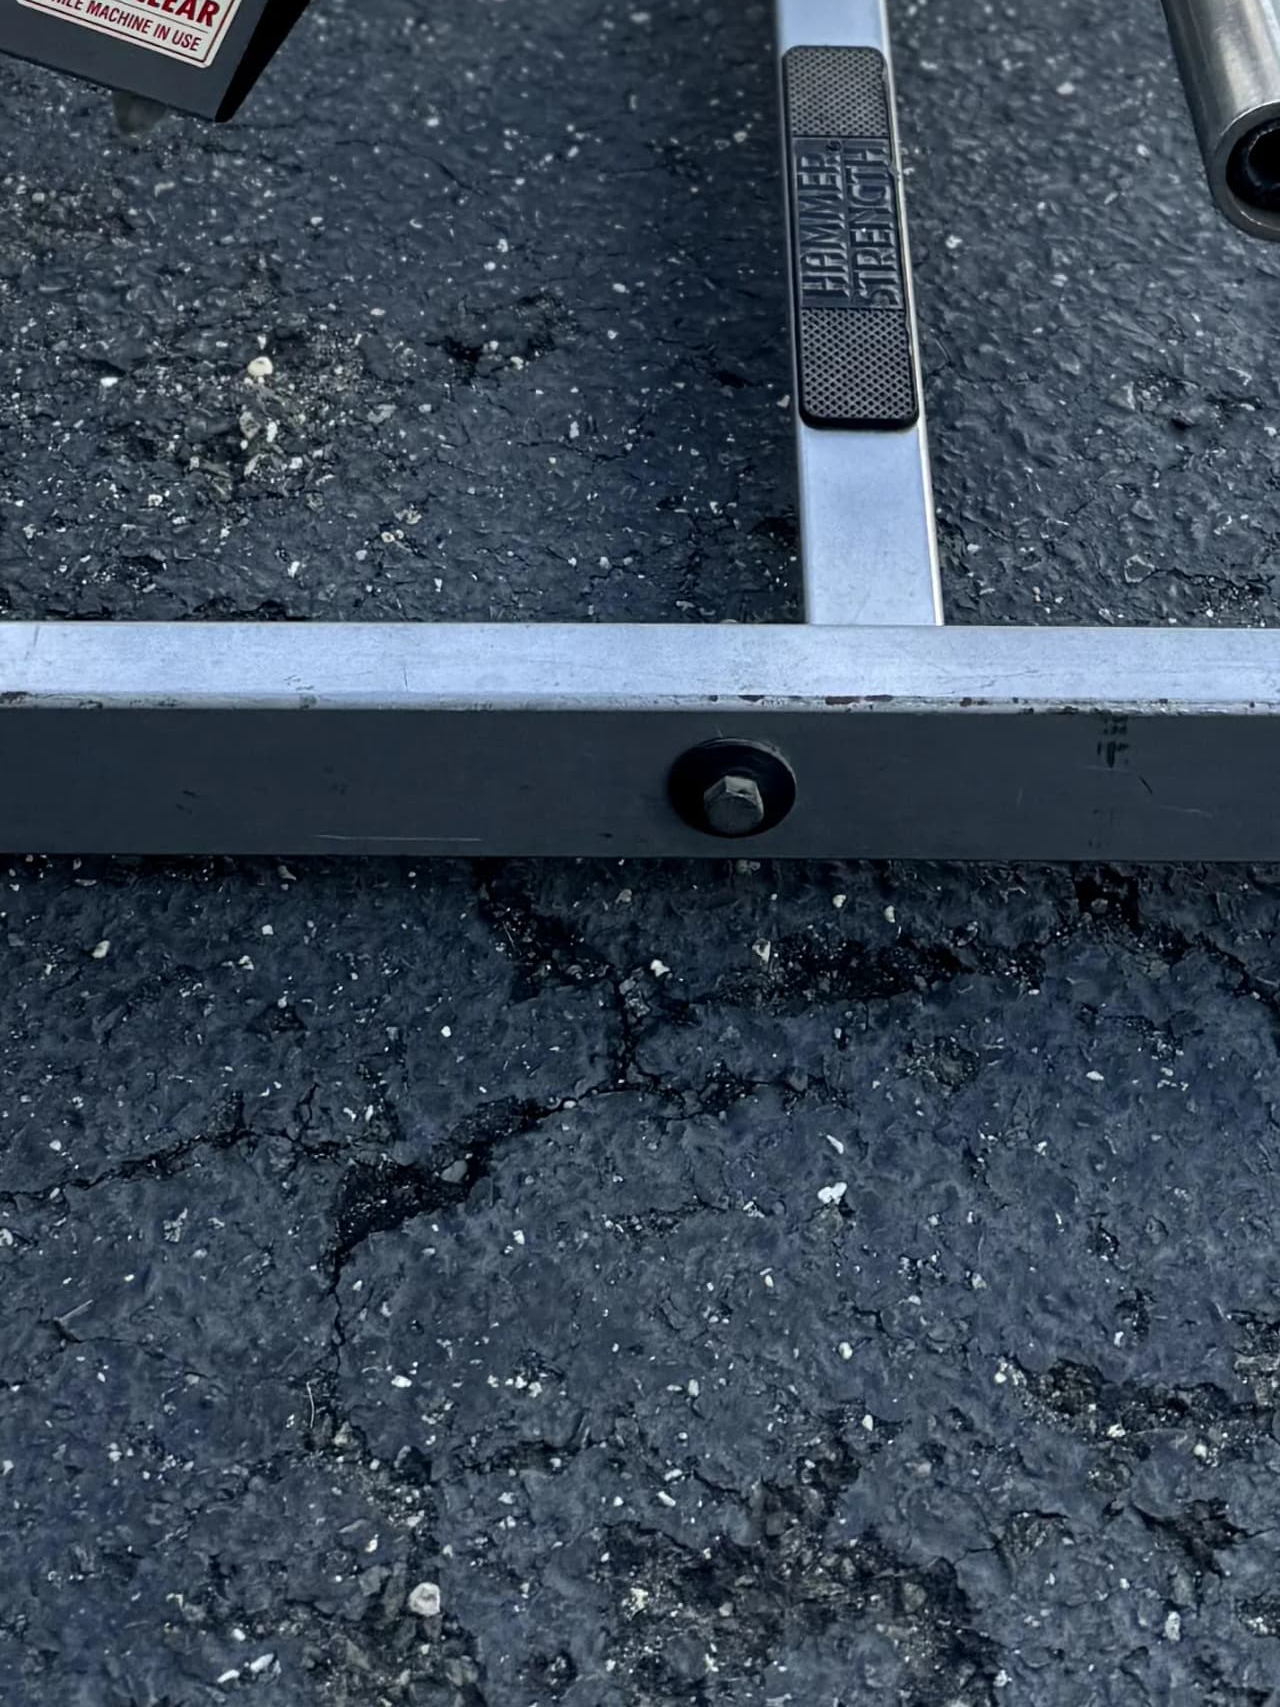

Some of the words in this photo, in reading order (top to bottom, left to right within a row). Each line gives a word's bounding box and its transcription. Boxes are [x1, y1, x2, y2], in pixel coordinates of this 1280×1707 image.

[85, 0, 154, 35] MACHINE
[154, 23, 172, 41] IN
[171, 29, 202, 52] USE
[797, 154, 850, 298] HAMMER
[844, 143, 903, 307] STRENGTH
